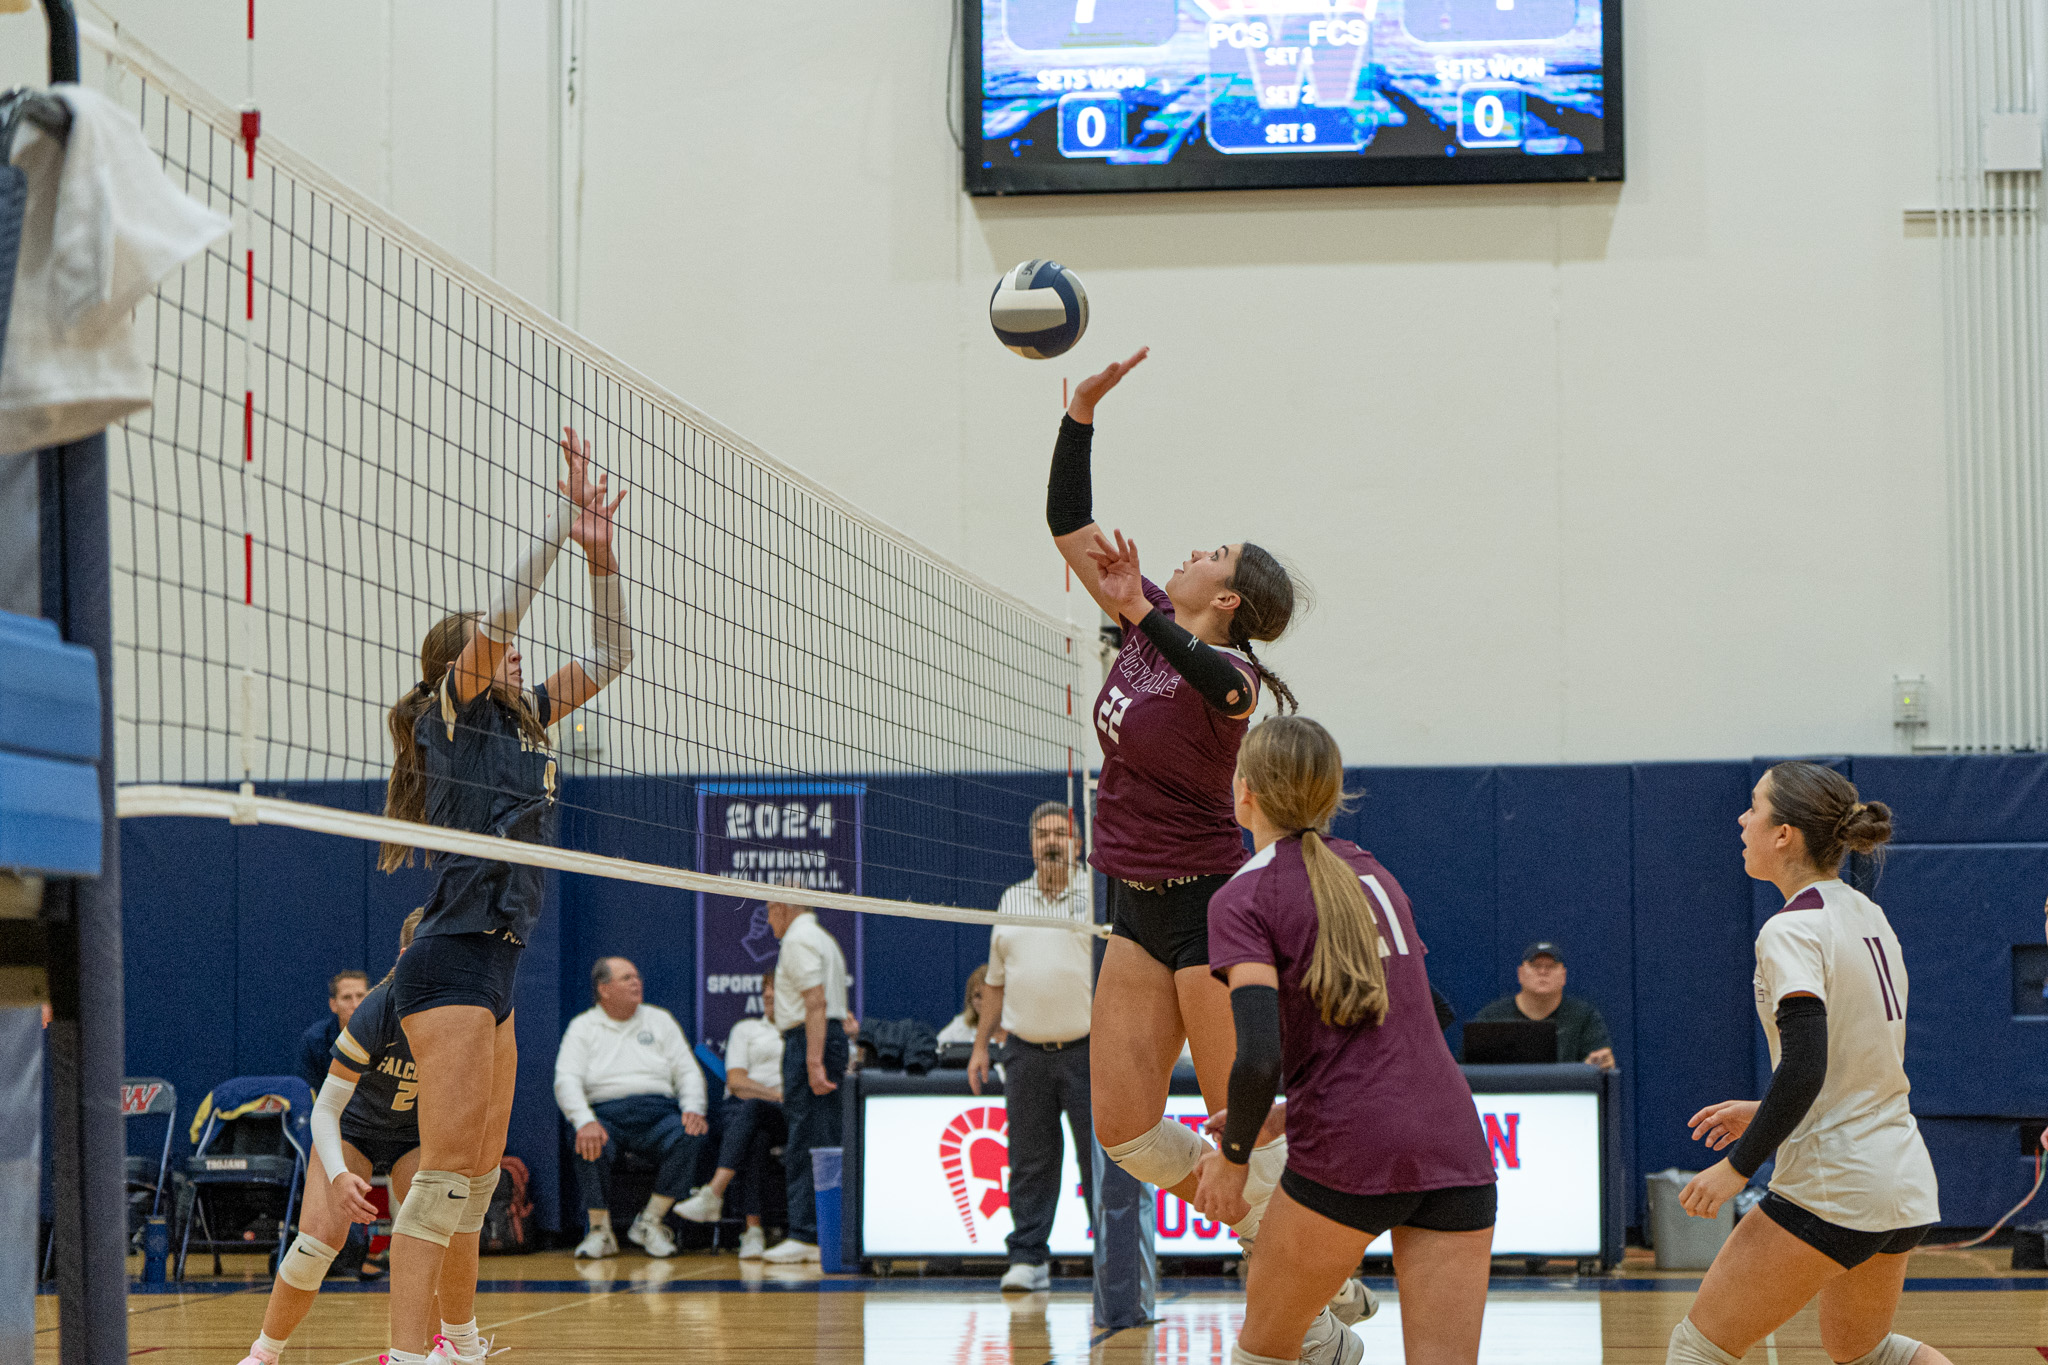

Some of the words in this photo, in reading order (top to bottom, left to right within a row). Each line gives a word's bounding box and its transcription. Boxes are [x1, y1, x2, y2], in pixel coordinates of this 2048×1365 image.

[1209, 22, 1269, 49] PCS
[1309, 19, 1368, 46] FCS
[1264, 47, 1299, 66] SET
[1434, 58, 1486, 80] SETS
[1488, 56, 1546, 79] WON
[1036, 69, 1087, 91] SETS
[1088, 67, 1146, 90] WON
[1265, 85, 1299, 105] SET
[1301, 84, 1315, 104] 2
[1076, 106, 1106, 147] 0
[1473, 95, 1504, 138] 0
[1265, 123, 1299, 143] SET
[1301, 122, 1316, 142] 3
[1097, 685, 1133, 745] 22
[725, 802, 837, 838] 2024
[1358, 874, 1409, 958] 1
[1862, 937, 1903, 1022] 11
